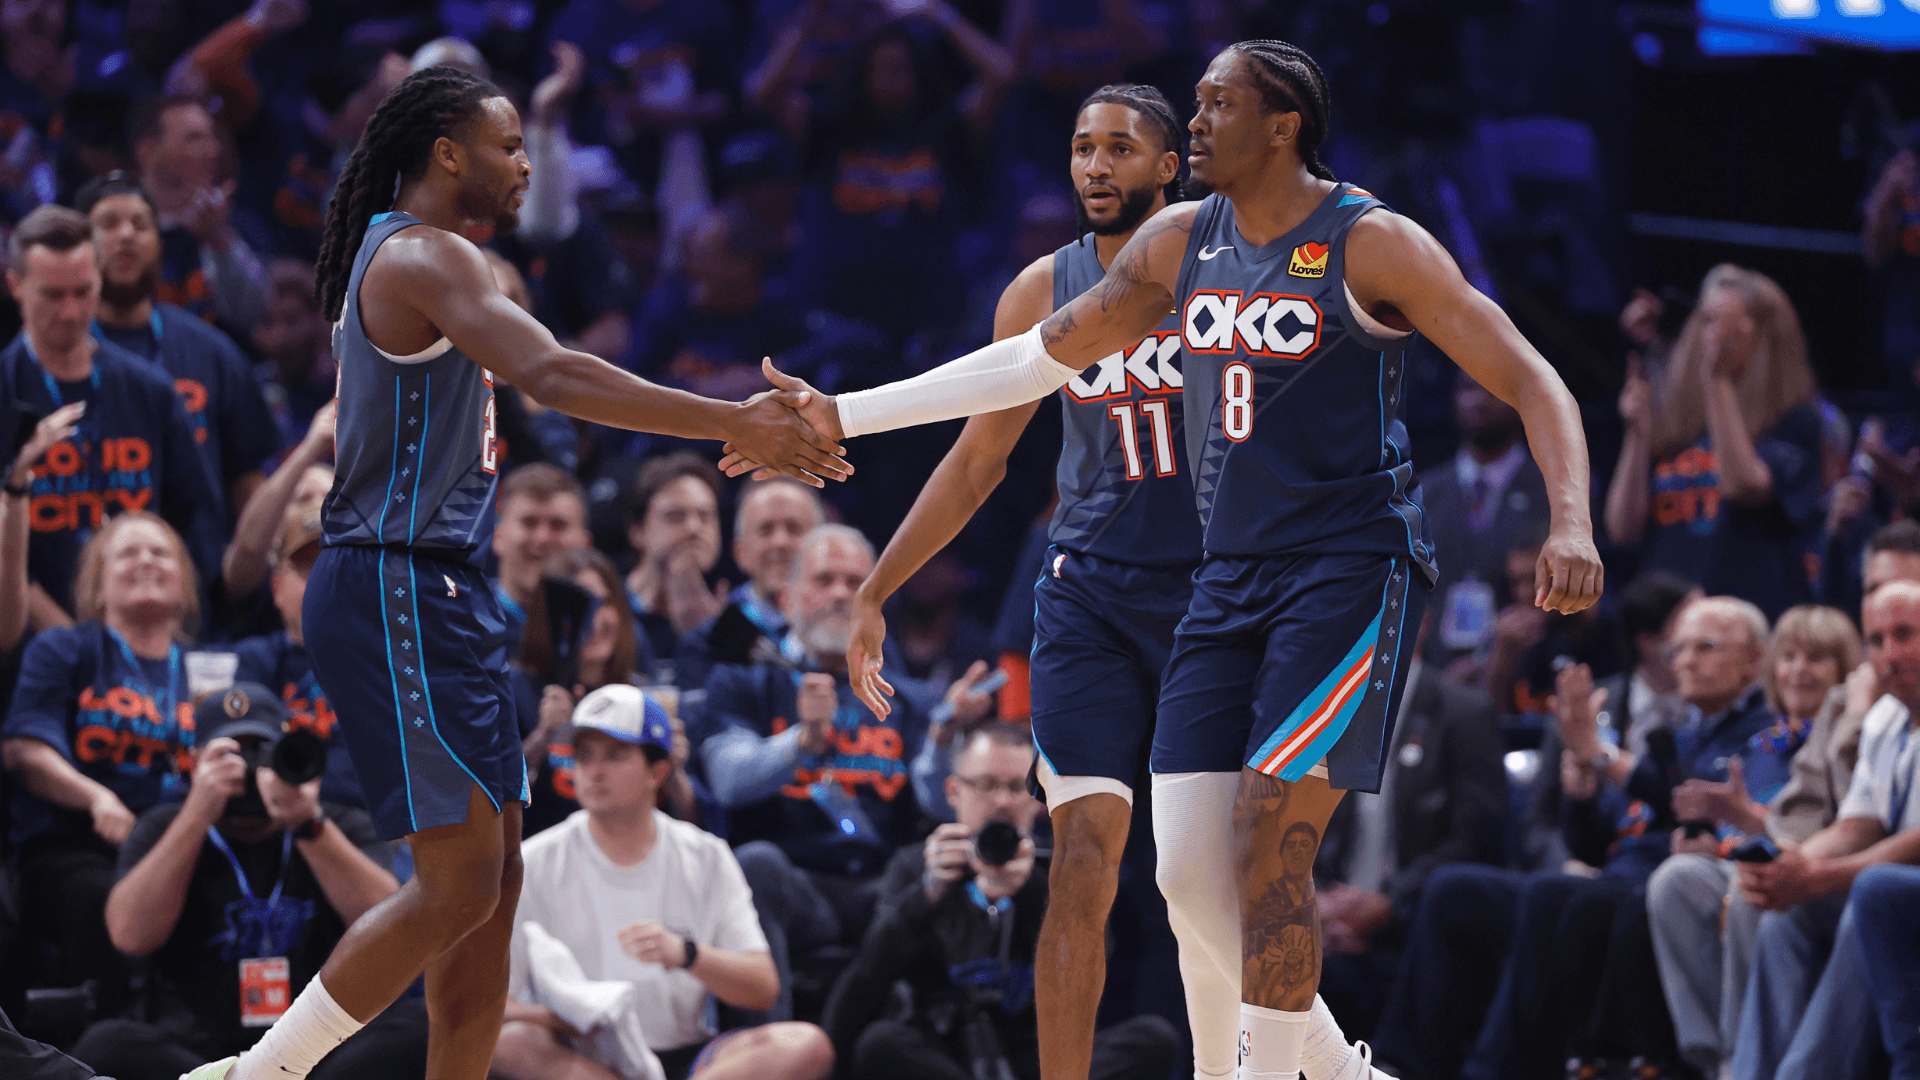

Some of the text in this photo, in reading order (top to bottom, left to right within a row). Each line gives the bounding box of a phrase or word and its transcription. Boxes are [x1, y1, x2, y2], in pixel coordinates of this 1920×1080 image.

[1182, 289, 1323, 360] OKC
[1107, 398, 1177, 481] 11
[1222, 361, 1254, 442] 8
